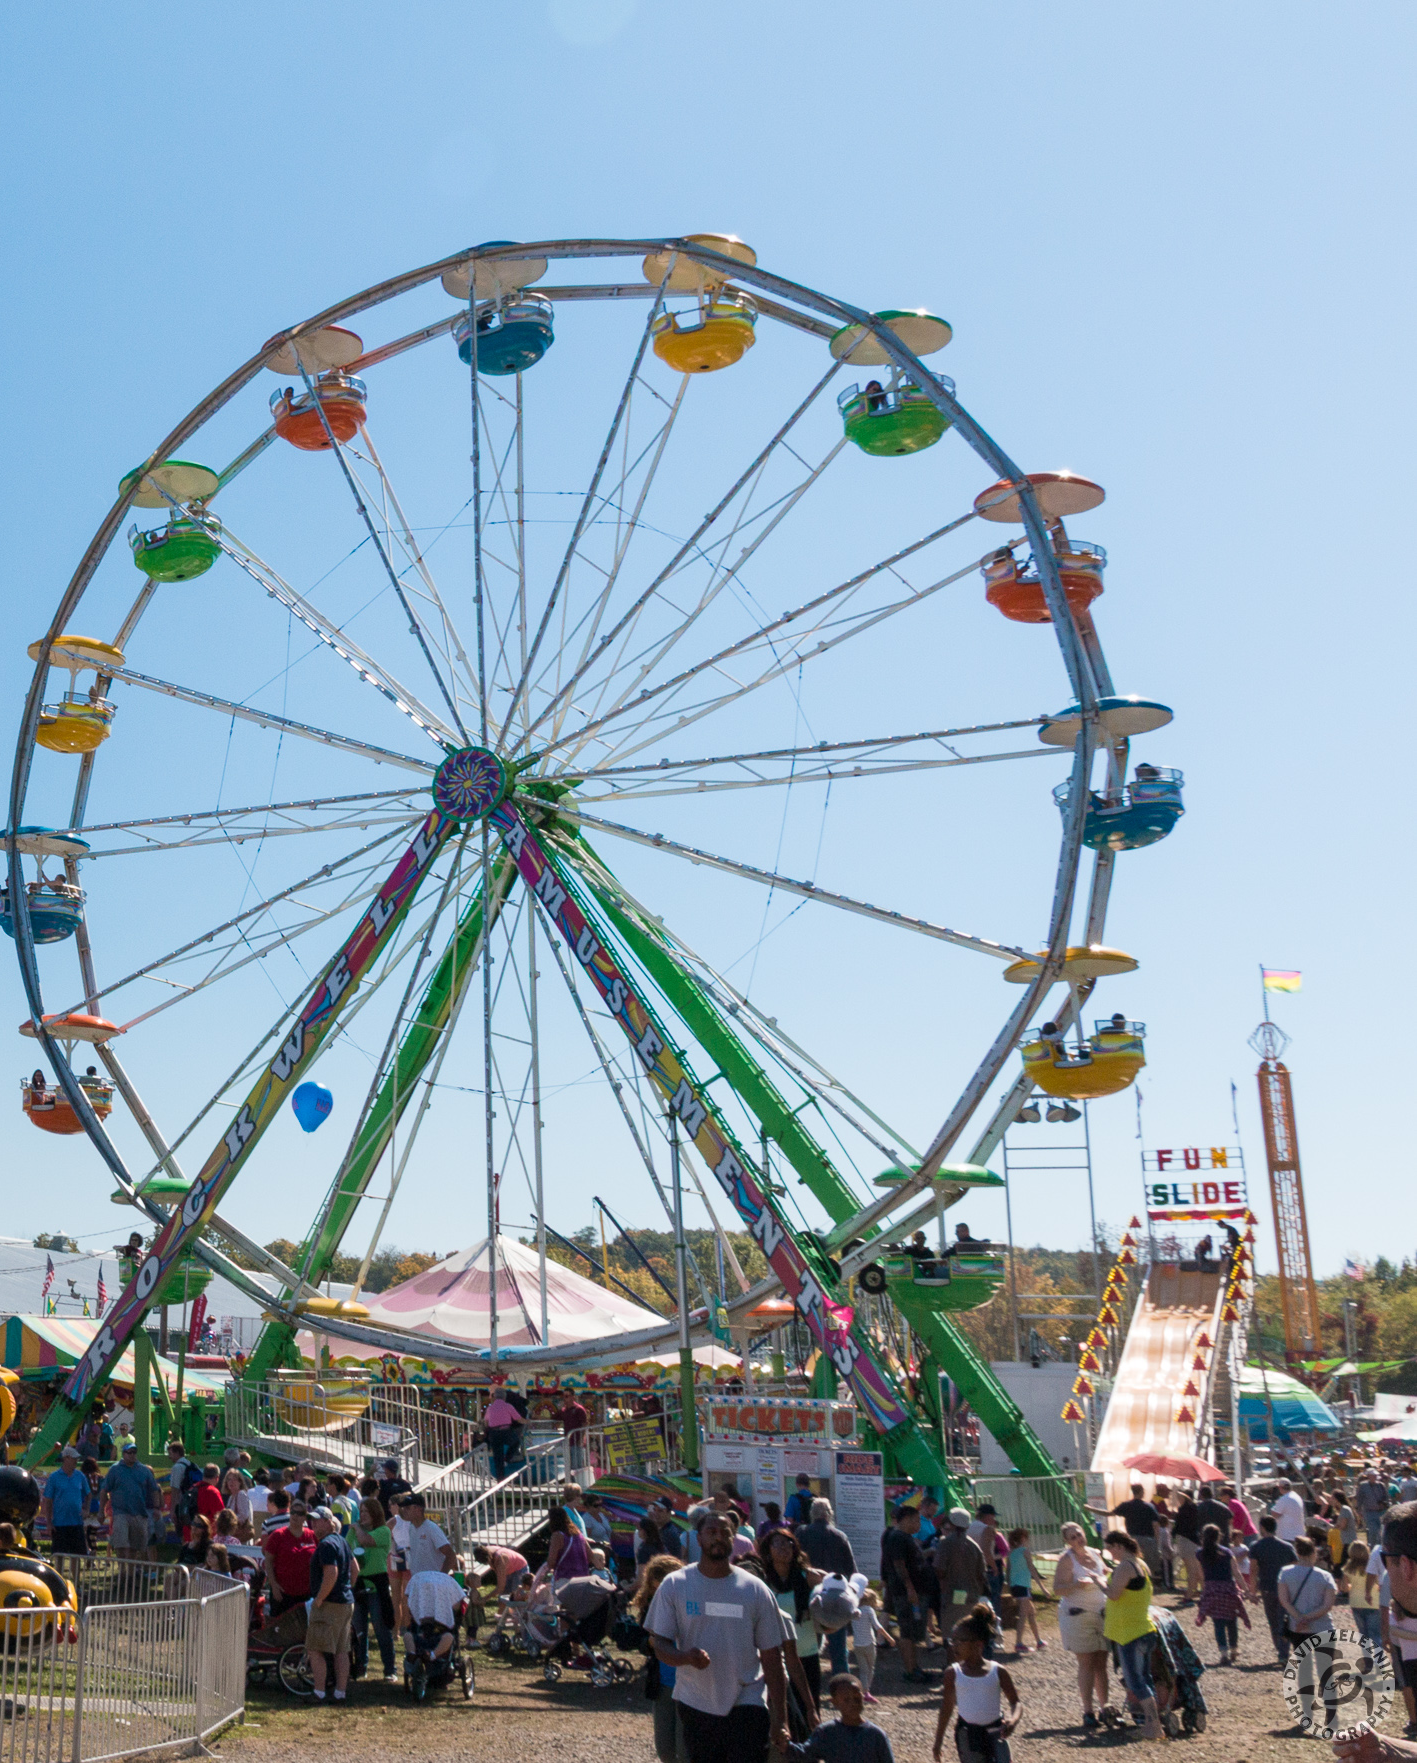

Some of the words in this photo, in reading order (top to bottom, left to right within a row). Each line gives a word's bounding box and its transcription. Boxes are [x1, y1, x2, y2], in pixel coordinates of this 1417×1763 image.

[86, 829, 439, 1380] ROCKWELL
[504, 819, 860, 1376] AMUSEMENTS
[1157, 1147, 1228, 1171] FUN
[1152, 1182, 1242, 1205] SLIDE
[711, 1406, 826, 1432] TICKETS
[838, 1463, 881, 1475] SMART
[843, 1453, 874, 1464] RIDE
